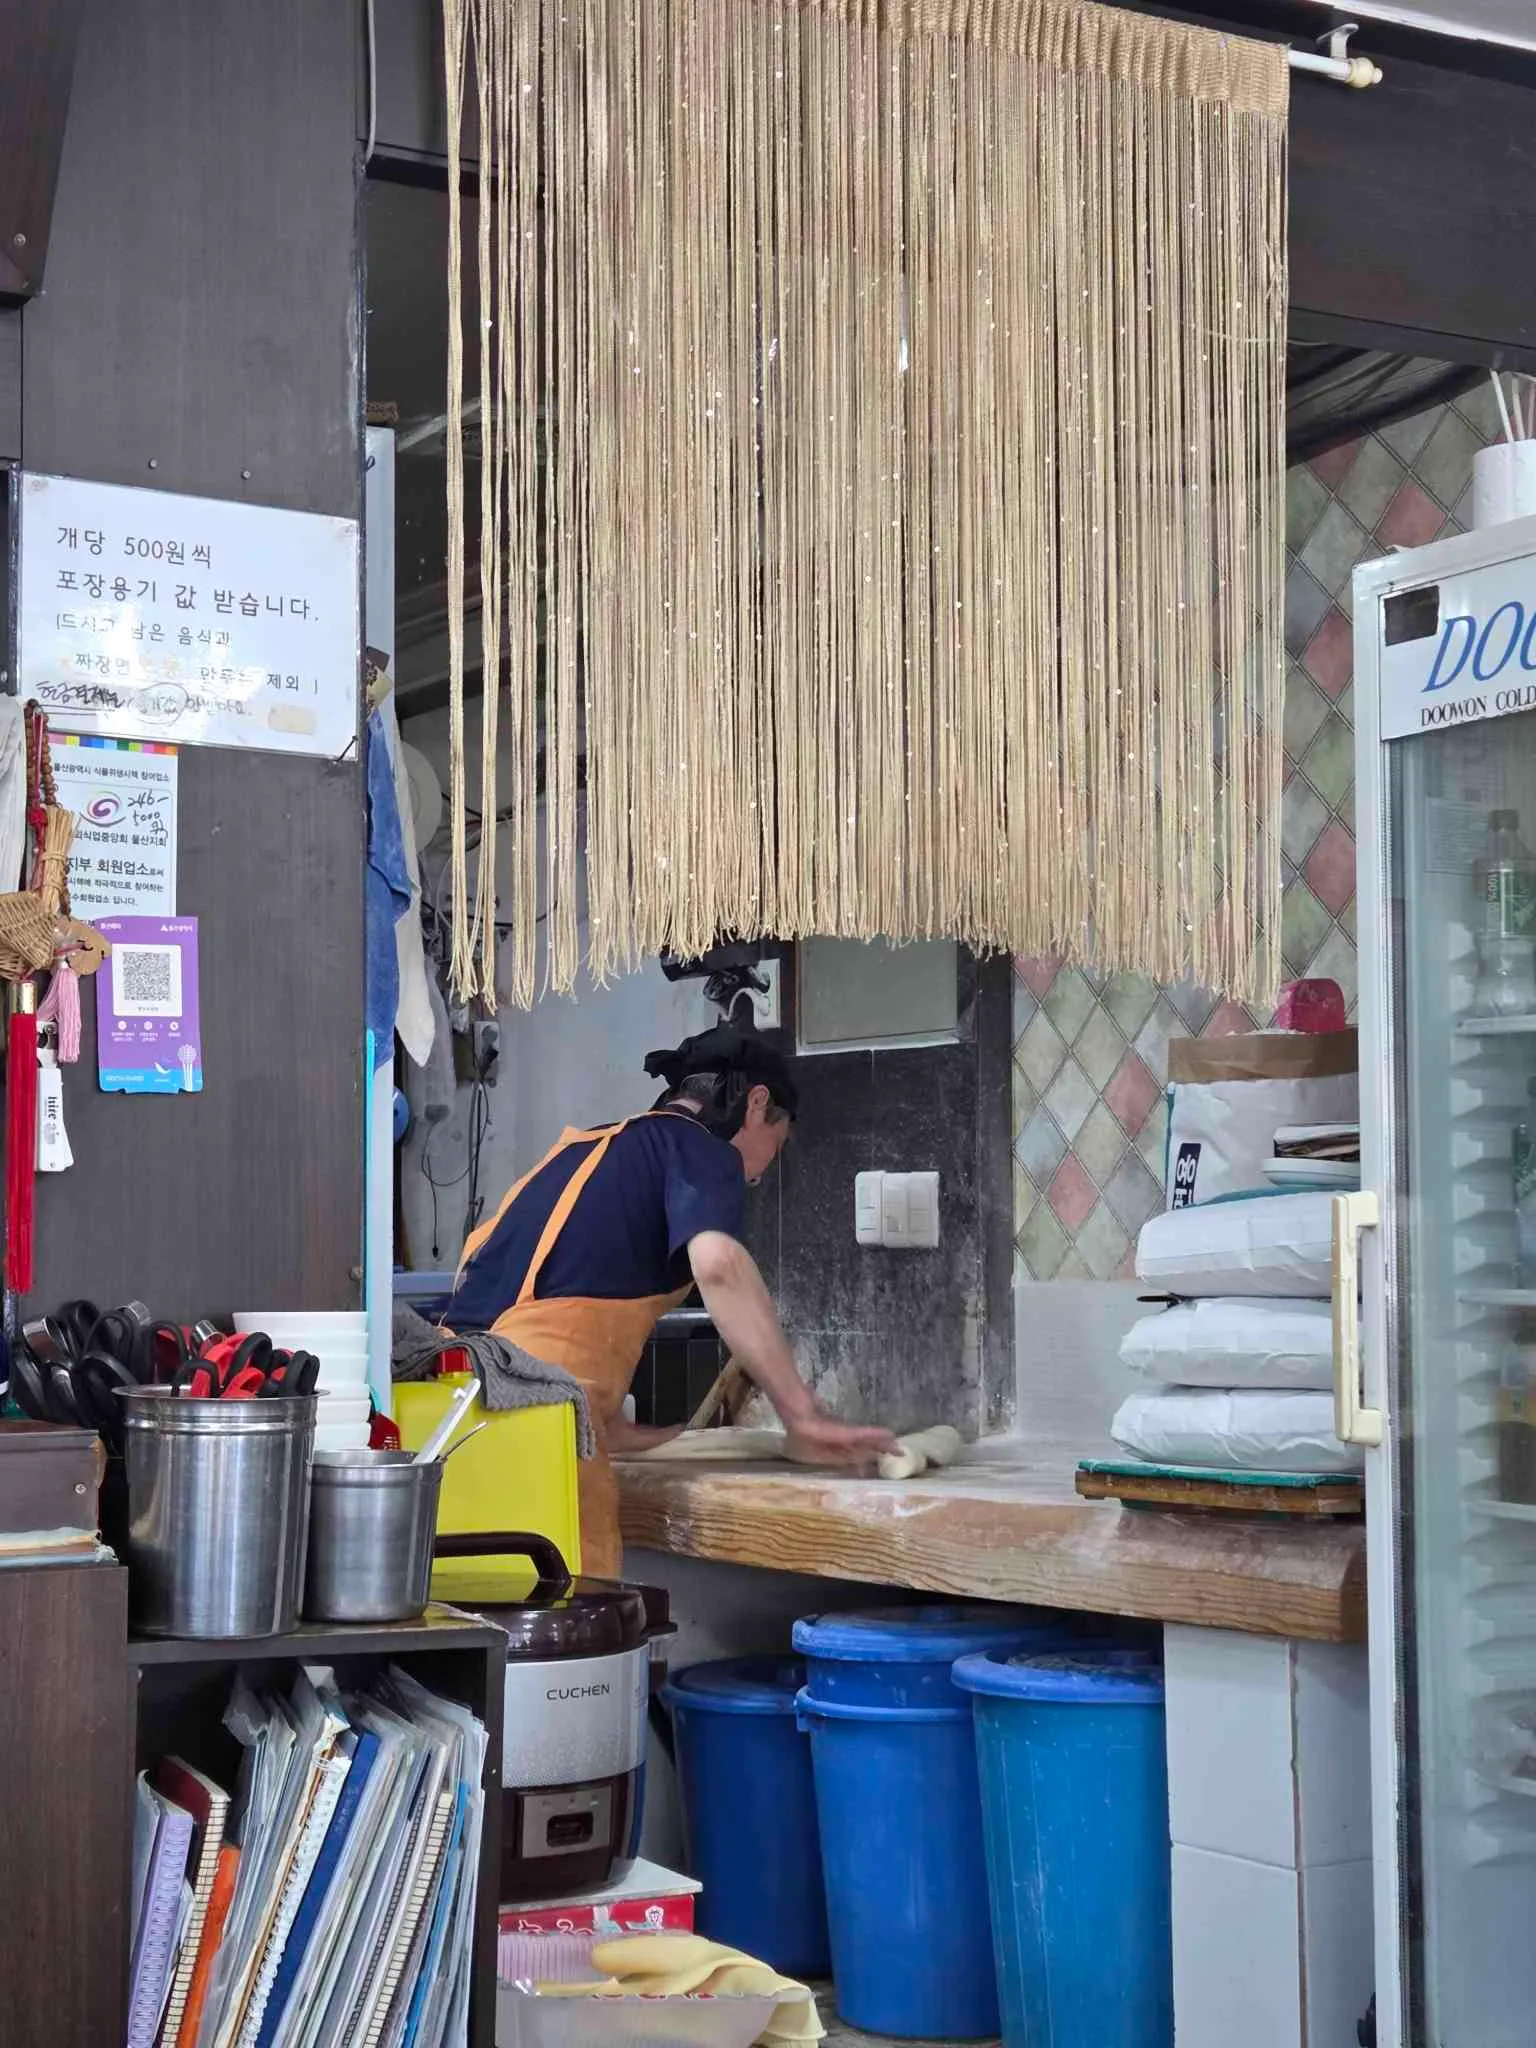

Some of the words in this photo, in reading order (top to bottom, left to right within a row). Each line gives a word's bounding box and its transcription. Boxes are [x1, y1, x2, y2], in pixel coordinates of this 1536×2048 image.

[57, 527, 106, 556] 개당
[56, 569, 157, 602] 포장용기
[174, 584, 197, 610] 값
[214, 589, 319, 621] 받습니다.
[177, 626, 231, 648] 음식과
[75, 653, 130, 674] 짜장면
[1421, 695, 1488, 727] DOOWON
[546, 1683, 611, 1701] CUCHEN
